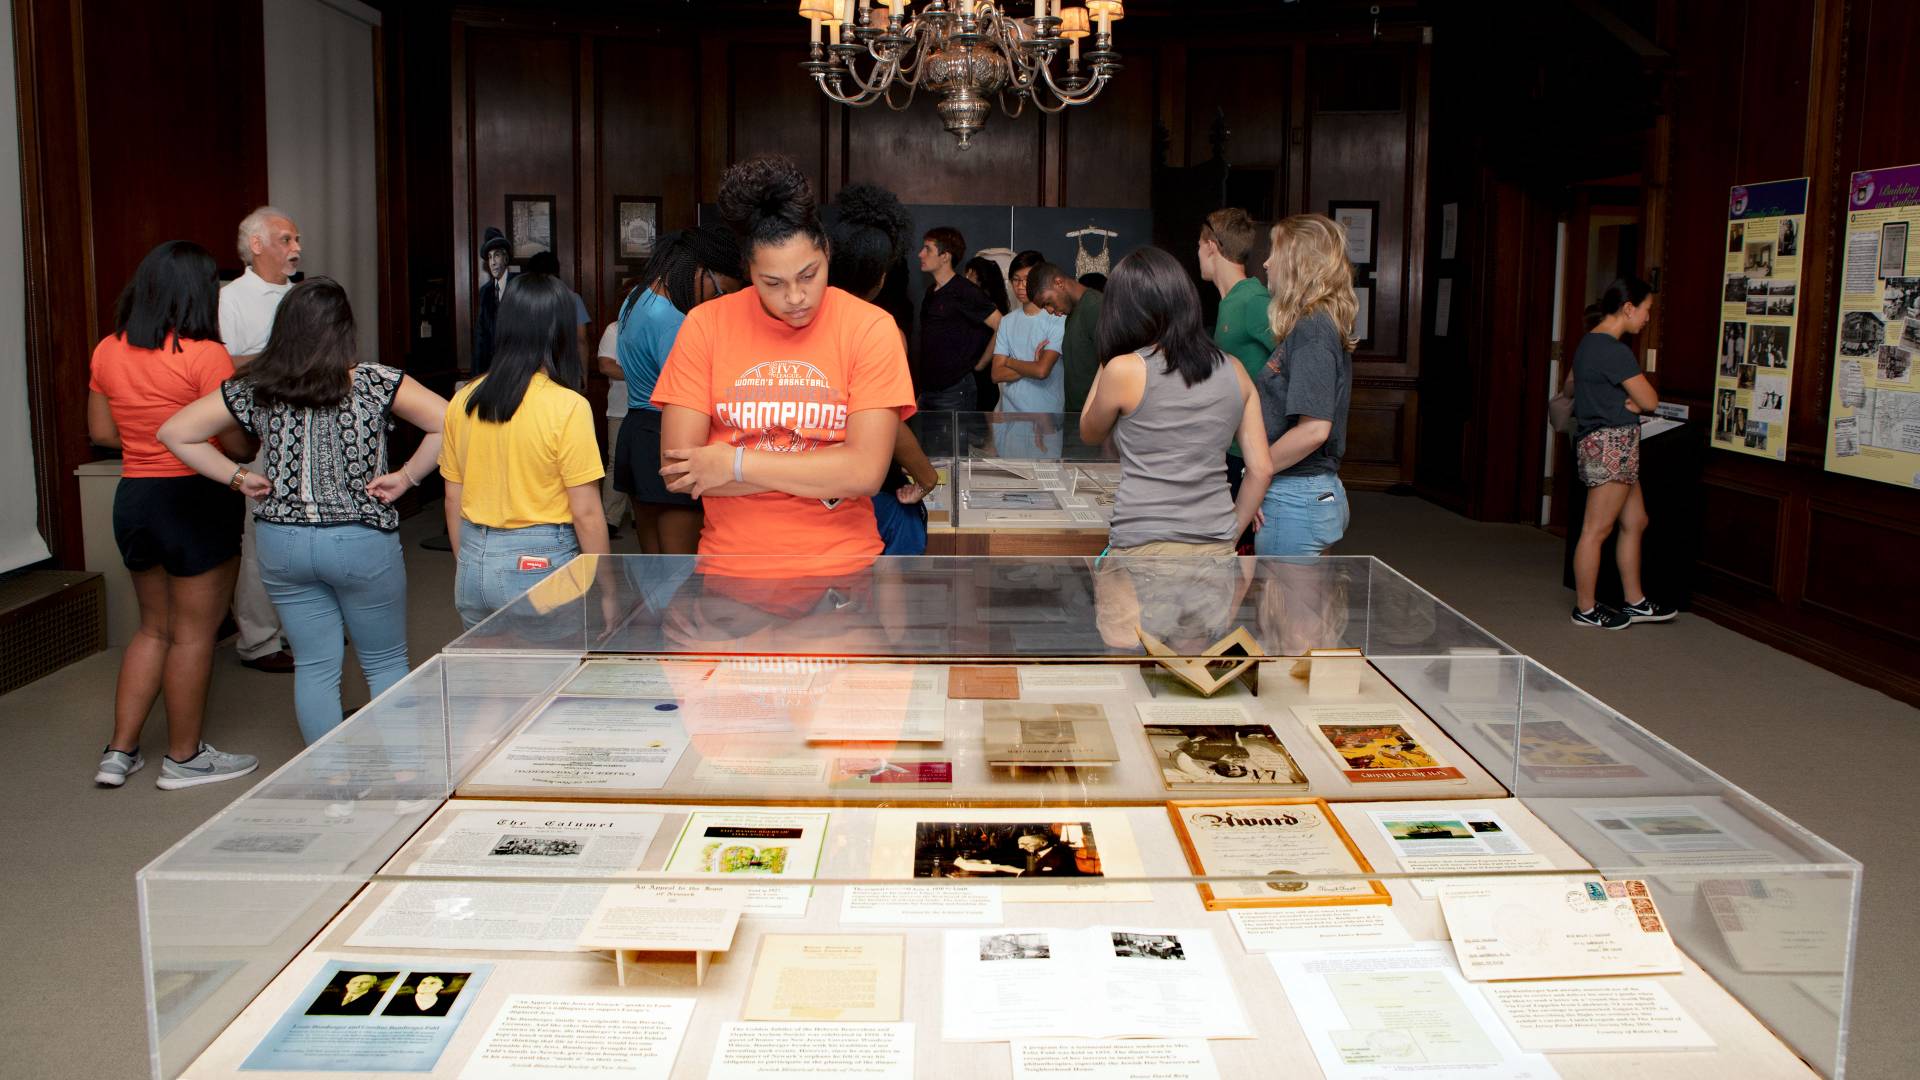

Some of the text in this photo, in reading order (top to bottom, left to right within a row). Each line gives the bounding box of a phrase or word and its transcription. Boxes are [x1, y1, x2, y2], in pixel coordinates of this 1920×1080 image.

[735, 378, 830, 389] WOMEN'S BASKETBALL
[716, 401, 848, 430] CHAMPIONS
[544, 820, 614, 828] Calumet
[1200, 812, 1300, 828] Award
